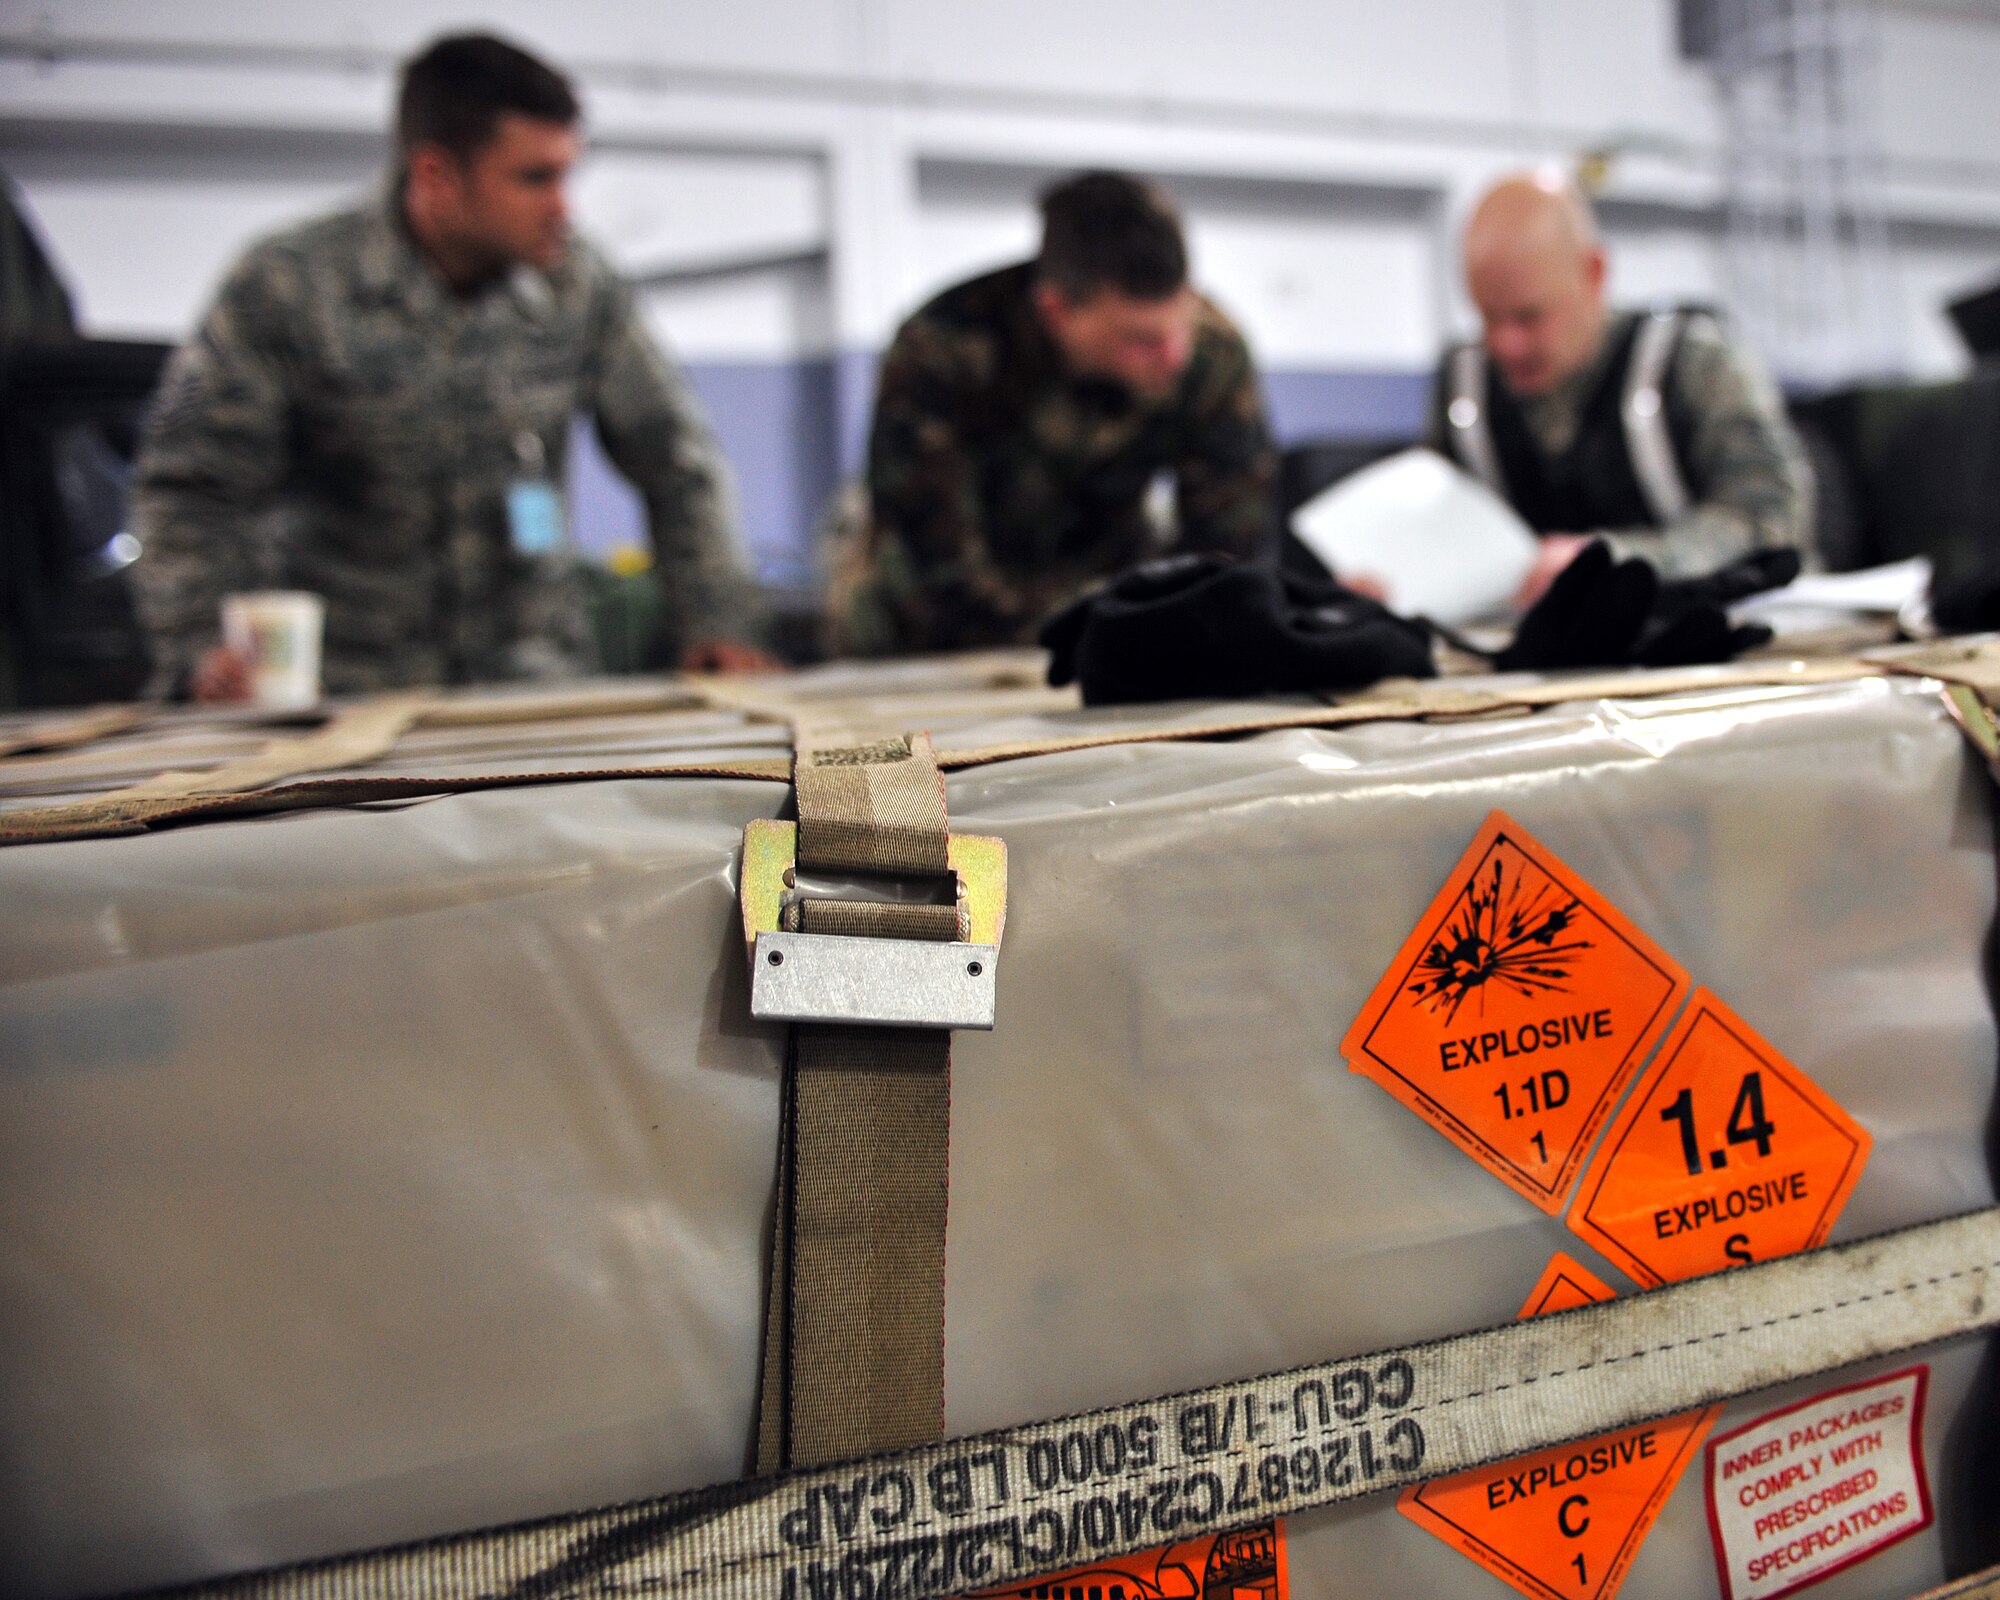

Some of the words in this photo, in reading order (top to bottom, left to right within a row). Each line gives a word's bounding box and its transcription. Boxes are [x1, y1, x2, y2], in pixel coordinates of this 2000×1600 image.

[1440, 1008, 1613, 1072] EXPLOSIVE
[1493, 1068, 1571, 1121] 1.1D
[1660, 1071, 1775, 1176] 1.4
[1530, 1130, 1549, 1164] 1
[1654, 1172, 1808, 1240] EXPLOSIVE
[1725, 1233, 1753, 1268] S
[1181, 1358, 1415, 1457] CGU-1/B
[1723, 1439, 1782, 1480] INNER
[1789, 1395, 1905, 1452] PACKAGES
[929, 1447, 1008, 1517] LB
[1026, 1416, 1160, 1492] 5000
[1487, 1430, 1658, 1511] EXPLOSIVE
[1739, 1455, 1823, 1507] COMPLY
[1830, 1431, 1882, 1466] WITH
[780, 1469, 913, 1547] CAP
[1558, 1494, 1590, 1539] C
[1747, 1491, 1908, 1582] SPECIFICATIONS
[1754, 1468, 1879, 1541] PRESCRIBED
[1571, 1553, 1588, 1586] 1
